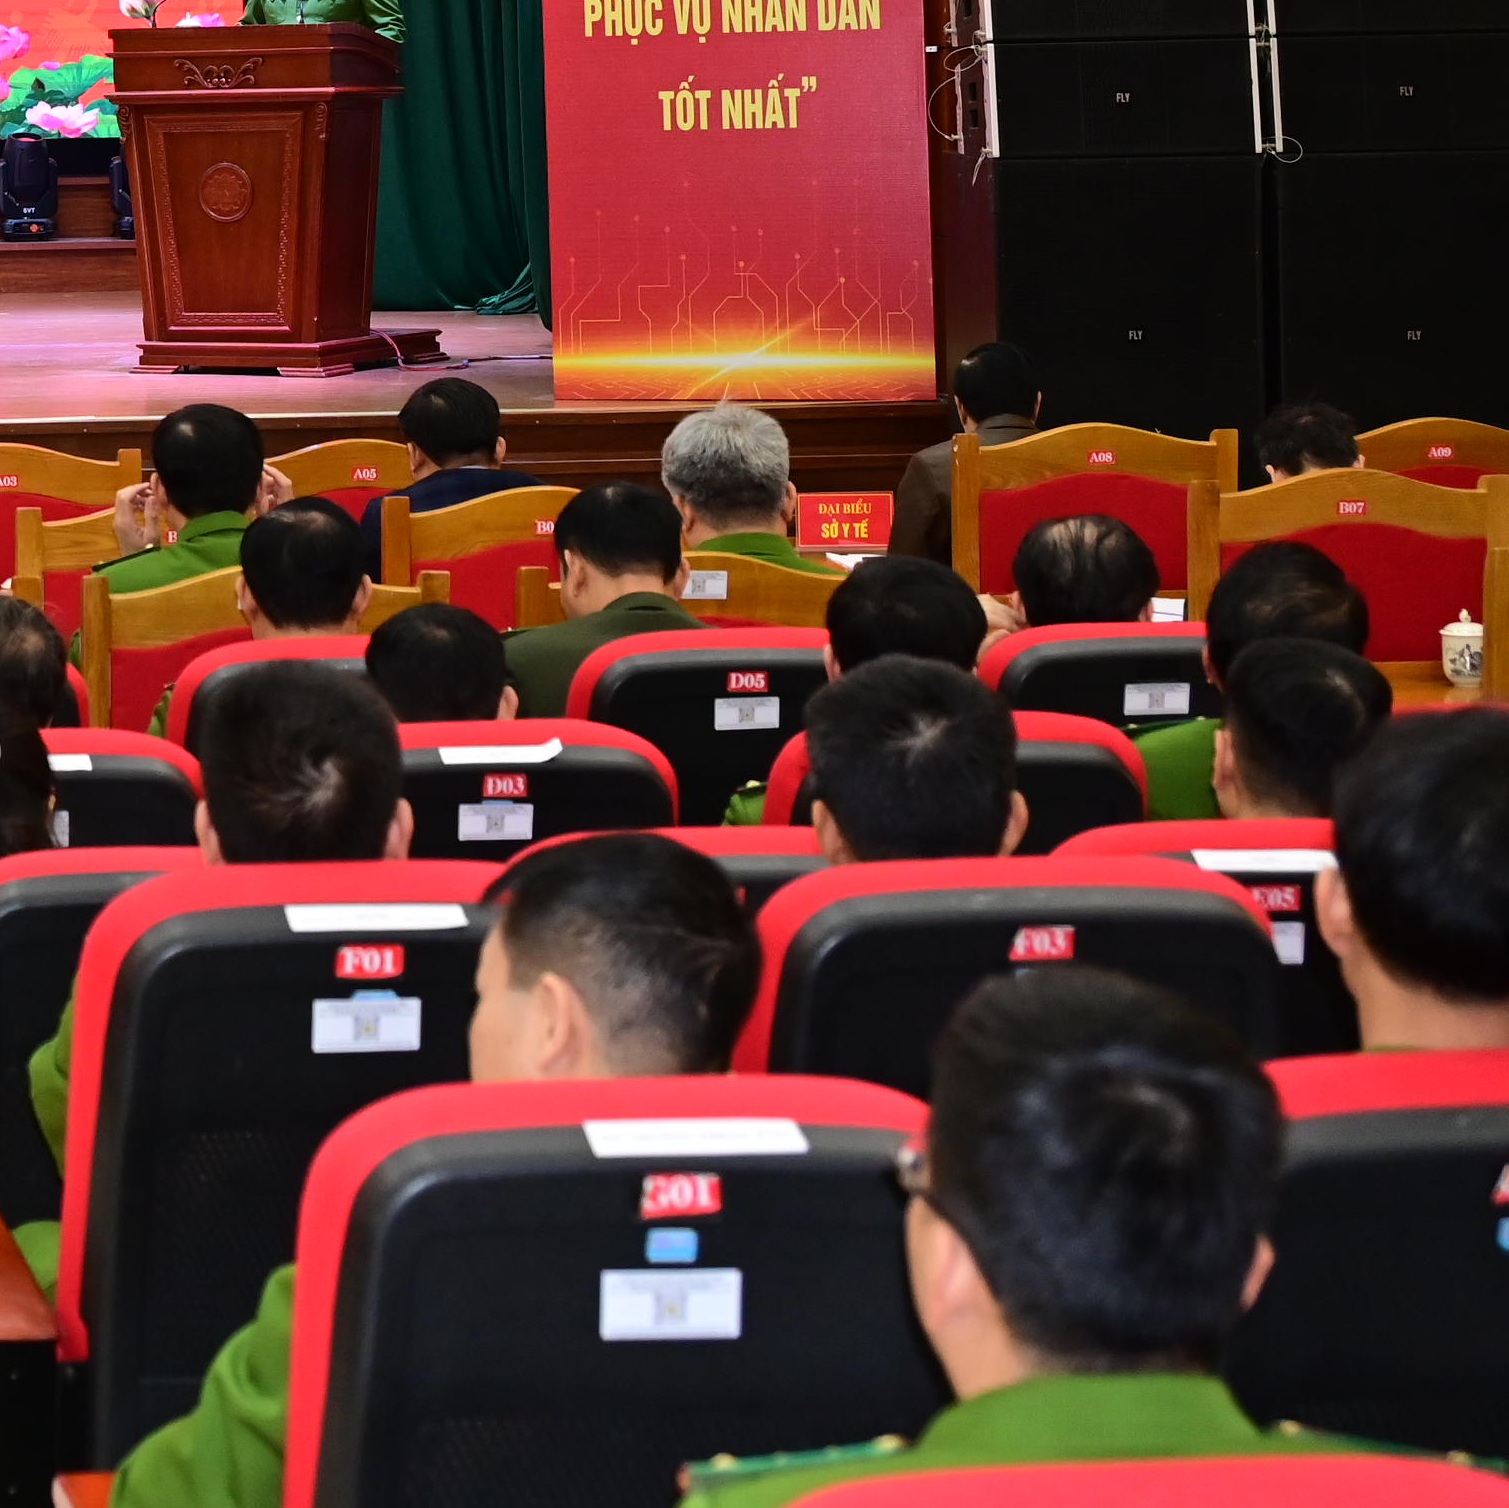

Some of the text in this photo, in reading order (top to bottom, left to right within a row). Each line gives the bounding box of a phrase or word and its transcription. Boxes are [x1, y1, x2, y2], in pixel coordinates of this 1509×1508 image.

[1089, 452, 1113, 462] A08
[1427, 447, 1452, 458] A09
[353, 468, 377, 479] A05
[818, 498, 873, 517] ĐẠI BIỂU
[1338, 502, 1365, 514] B07
[820, 517, 870, 539] SỞ Y TẾ
[728, 670, 767, 689] D05
[341, 947, 397, 975] F01
